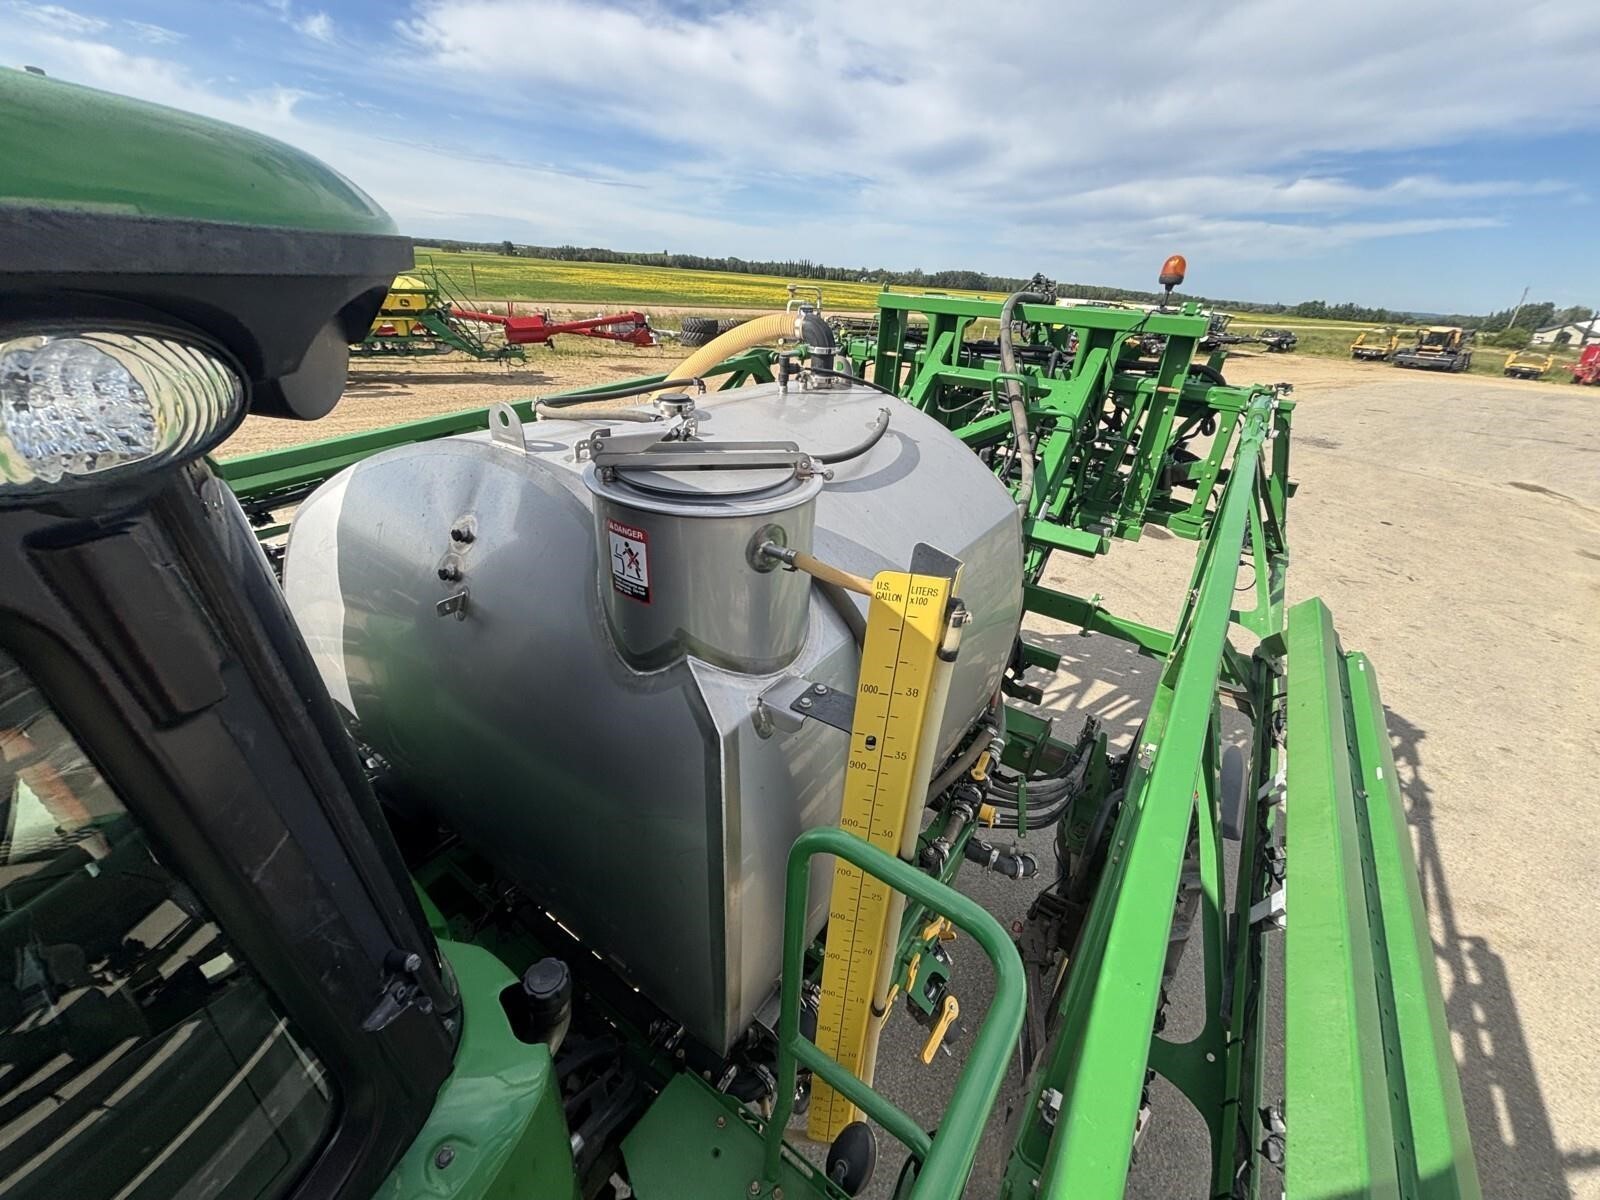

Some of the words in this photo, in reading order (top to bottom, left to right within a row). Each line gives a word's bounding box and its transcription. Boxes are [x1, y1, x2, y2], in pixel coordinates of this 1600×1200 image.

[614, 523, 643, 540] DANGER
[876, 581, 891, 591] U.S.
[911, 586, 938, 597] LITERS
[875, 591, 902, 603] GALLON
[860, 683, 878, 694] 1000
[905, 688, 919, 698] 38
[894, 751, 907, 760] 35
[849, 760, 867, 770] 900
[881, 829, 893, 838] 30
[836, 868, 851, 877] 700
[830, 912, 846, 920] 600
